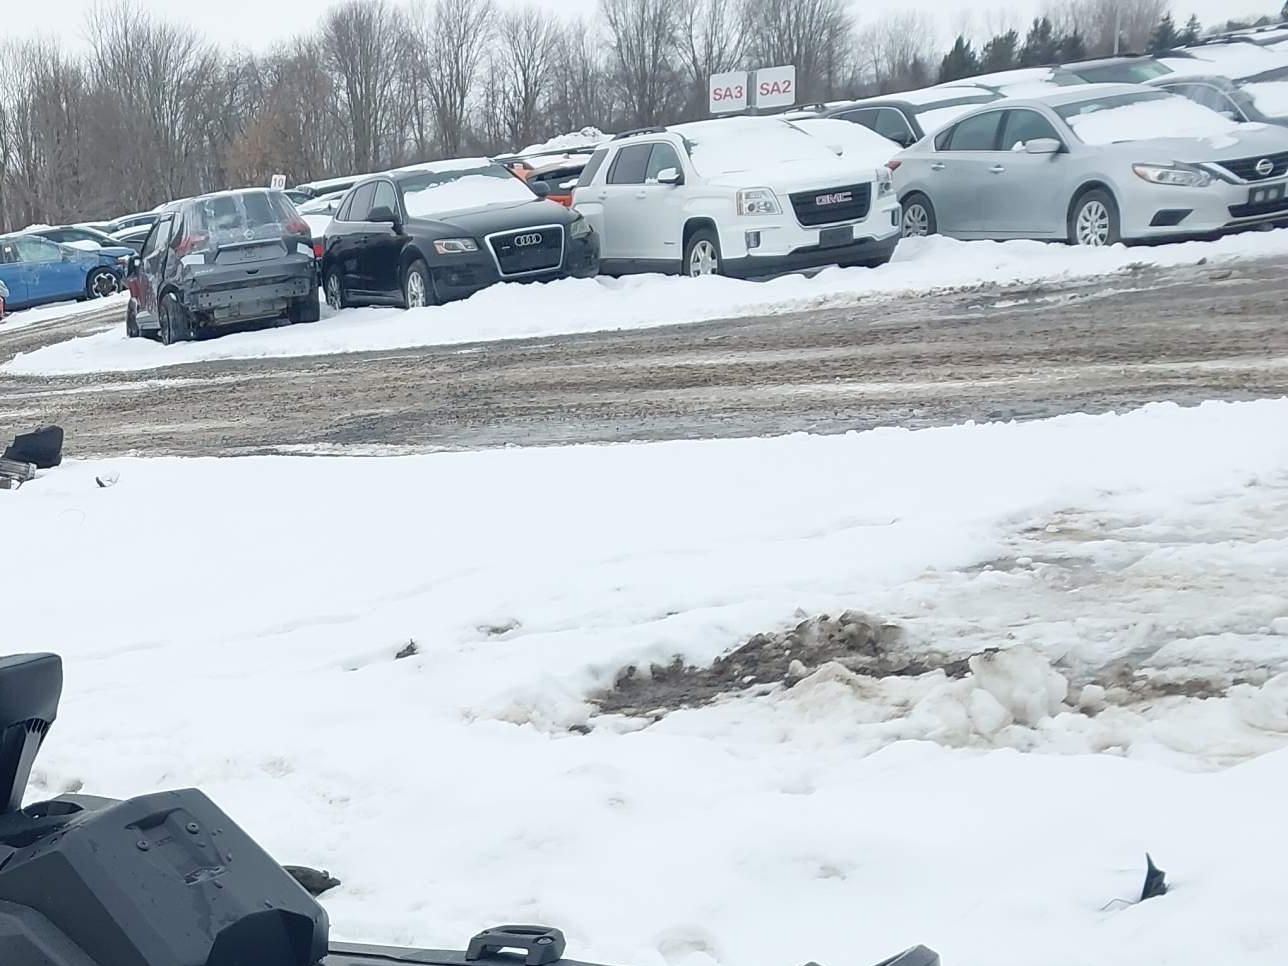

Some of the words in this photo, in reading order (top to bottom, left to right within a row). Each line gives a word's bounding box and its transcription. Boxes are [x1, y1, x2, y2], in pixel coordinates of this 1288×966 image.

[713, 85, 743, 101] SA3
[759, 80, 791, 96] SA2
[815, 191, 852, 205] GMC
